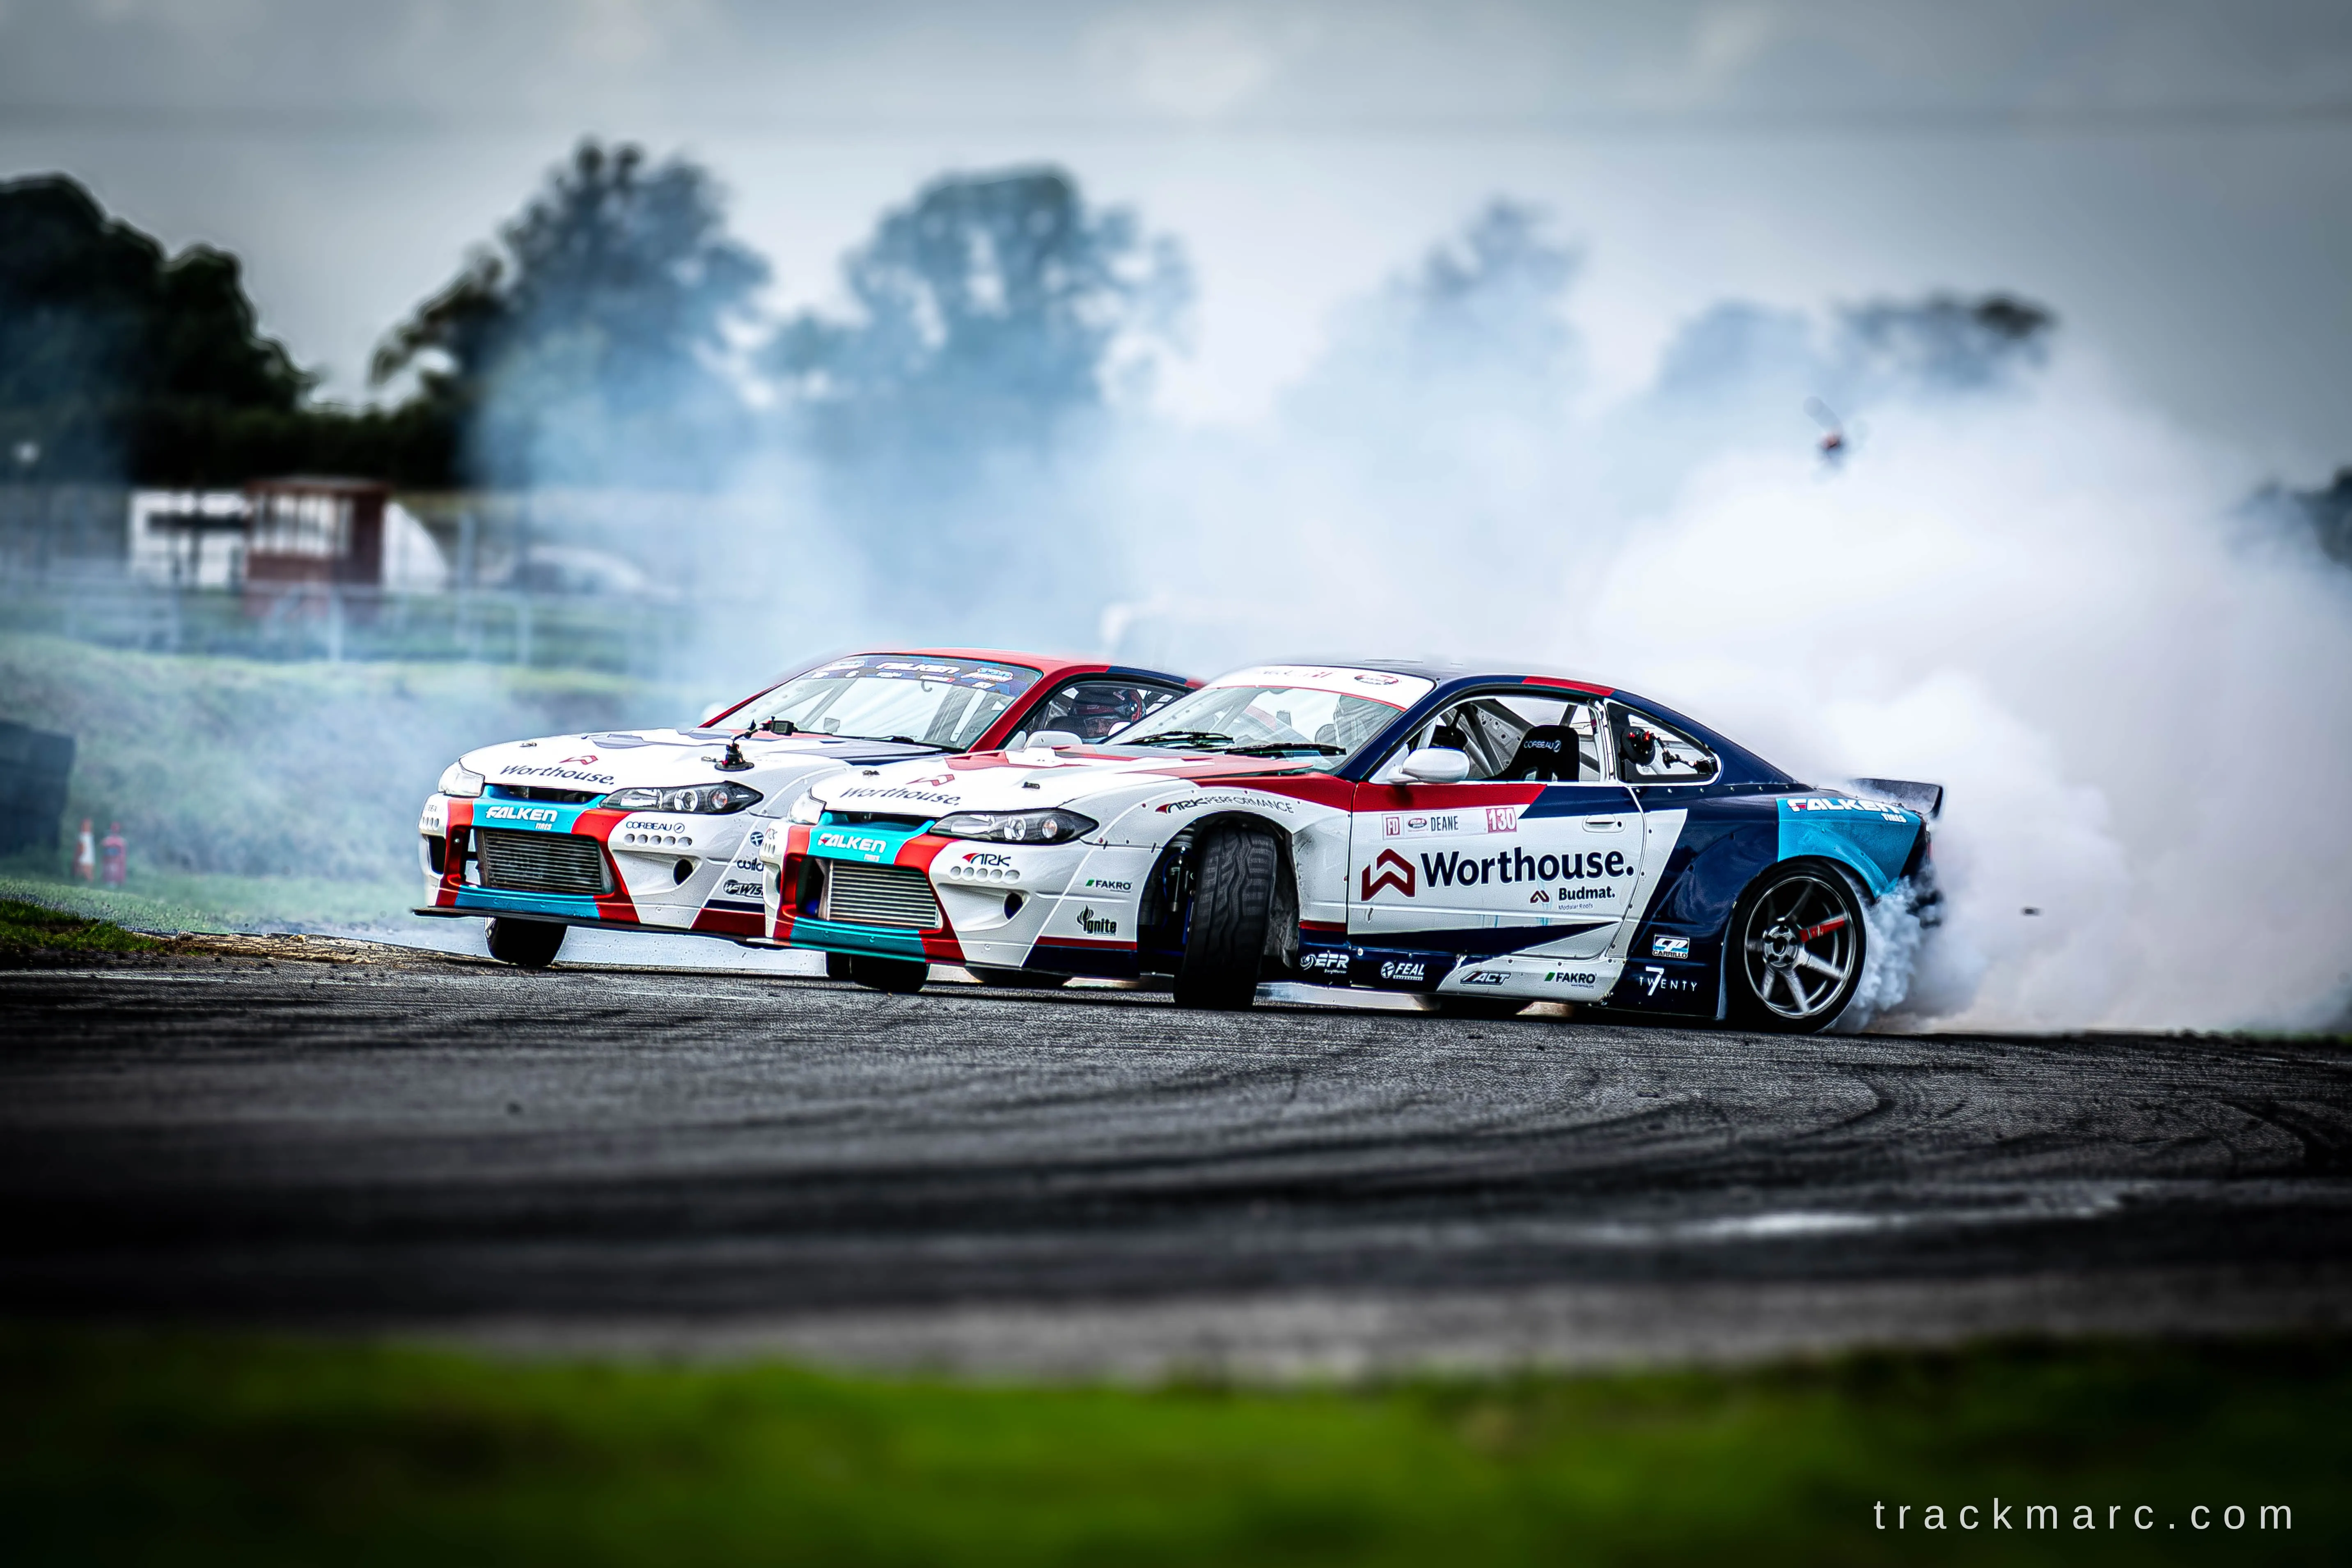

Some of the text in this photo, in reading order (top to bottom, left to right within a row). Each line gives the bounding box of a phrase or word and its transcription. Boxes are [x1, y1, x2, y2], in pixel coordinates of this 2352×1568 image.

[500, 766, 614, 785] Worthouse.
[839, 788, 961, 805] Worthouse.
[1206, 796, 1294, 814] PERFORMANCE
[1787, 798, 1900, 814] FALKEN
[486, 807, 558, 822] FALKEN
[1488, 808, 1515, 830] 130
[626, 821, 672, 831] CORBEAU
[1431, 816, 1459, 832] DEANE
[818, 833, 887, 853] FALKEN
[1421, 846, 1634, 887] Worthouse.
[739, 884, 763, 895] WIS
[1096, 880, 1131, 890] FAKRO
[1559, 886, 1615, 901] Budmat.
[1314, 954, 1349, 968] EFR
[1653, 950, 1687, 958] CARRILLO
[1395, 963, 1424, 975] FEAL
[1556, 972, 1596, 984] FAKRO
[1639, 976, 1697, 991] TWENTY
